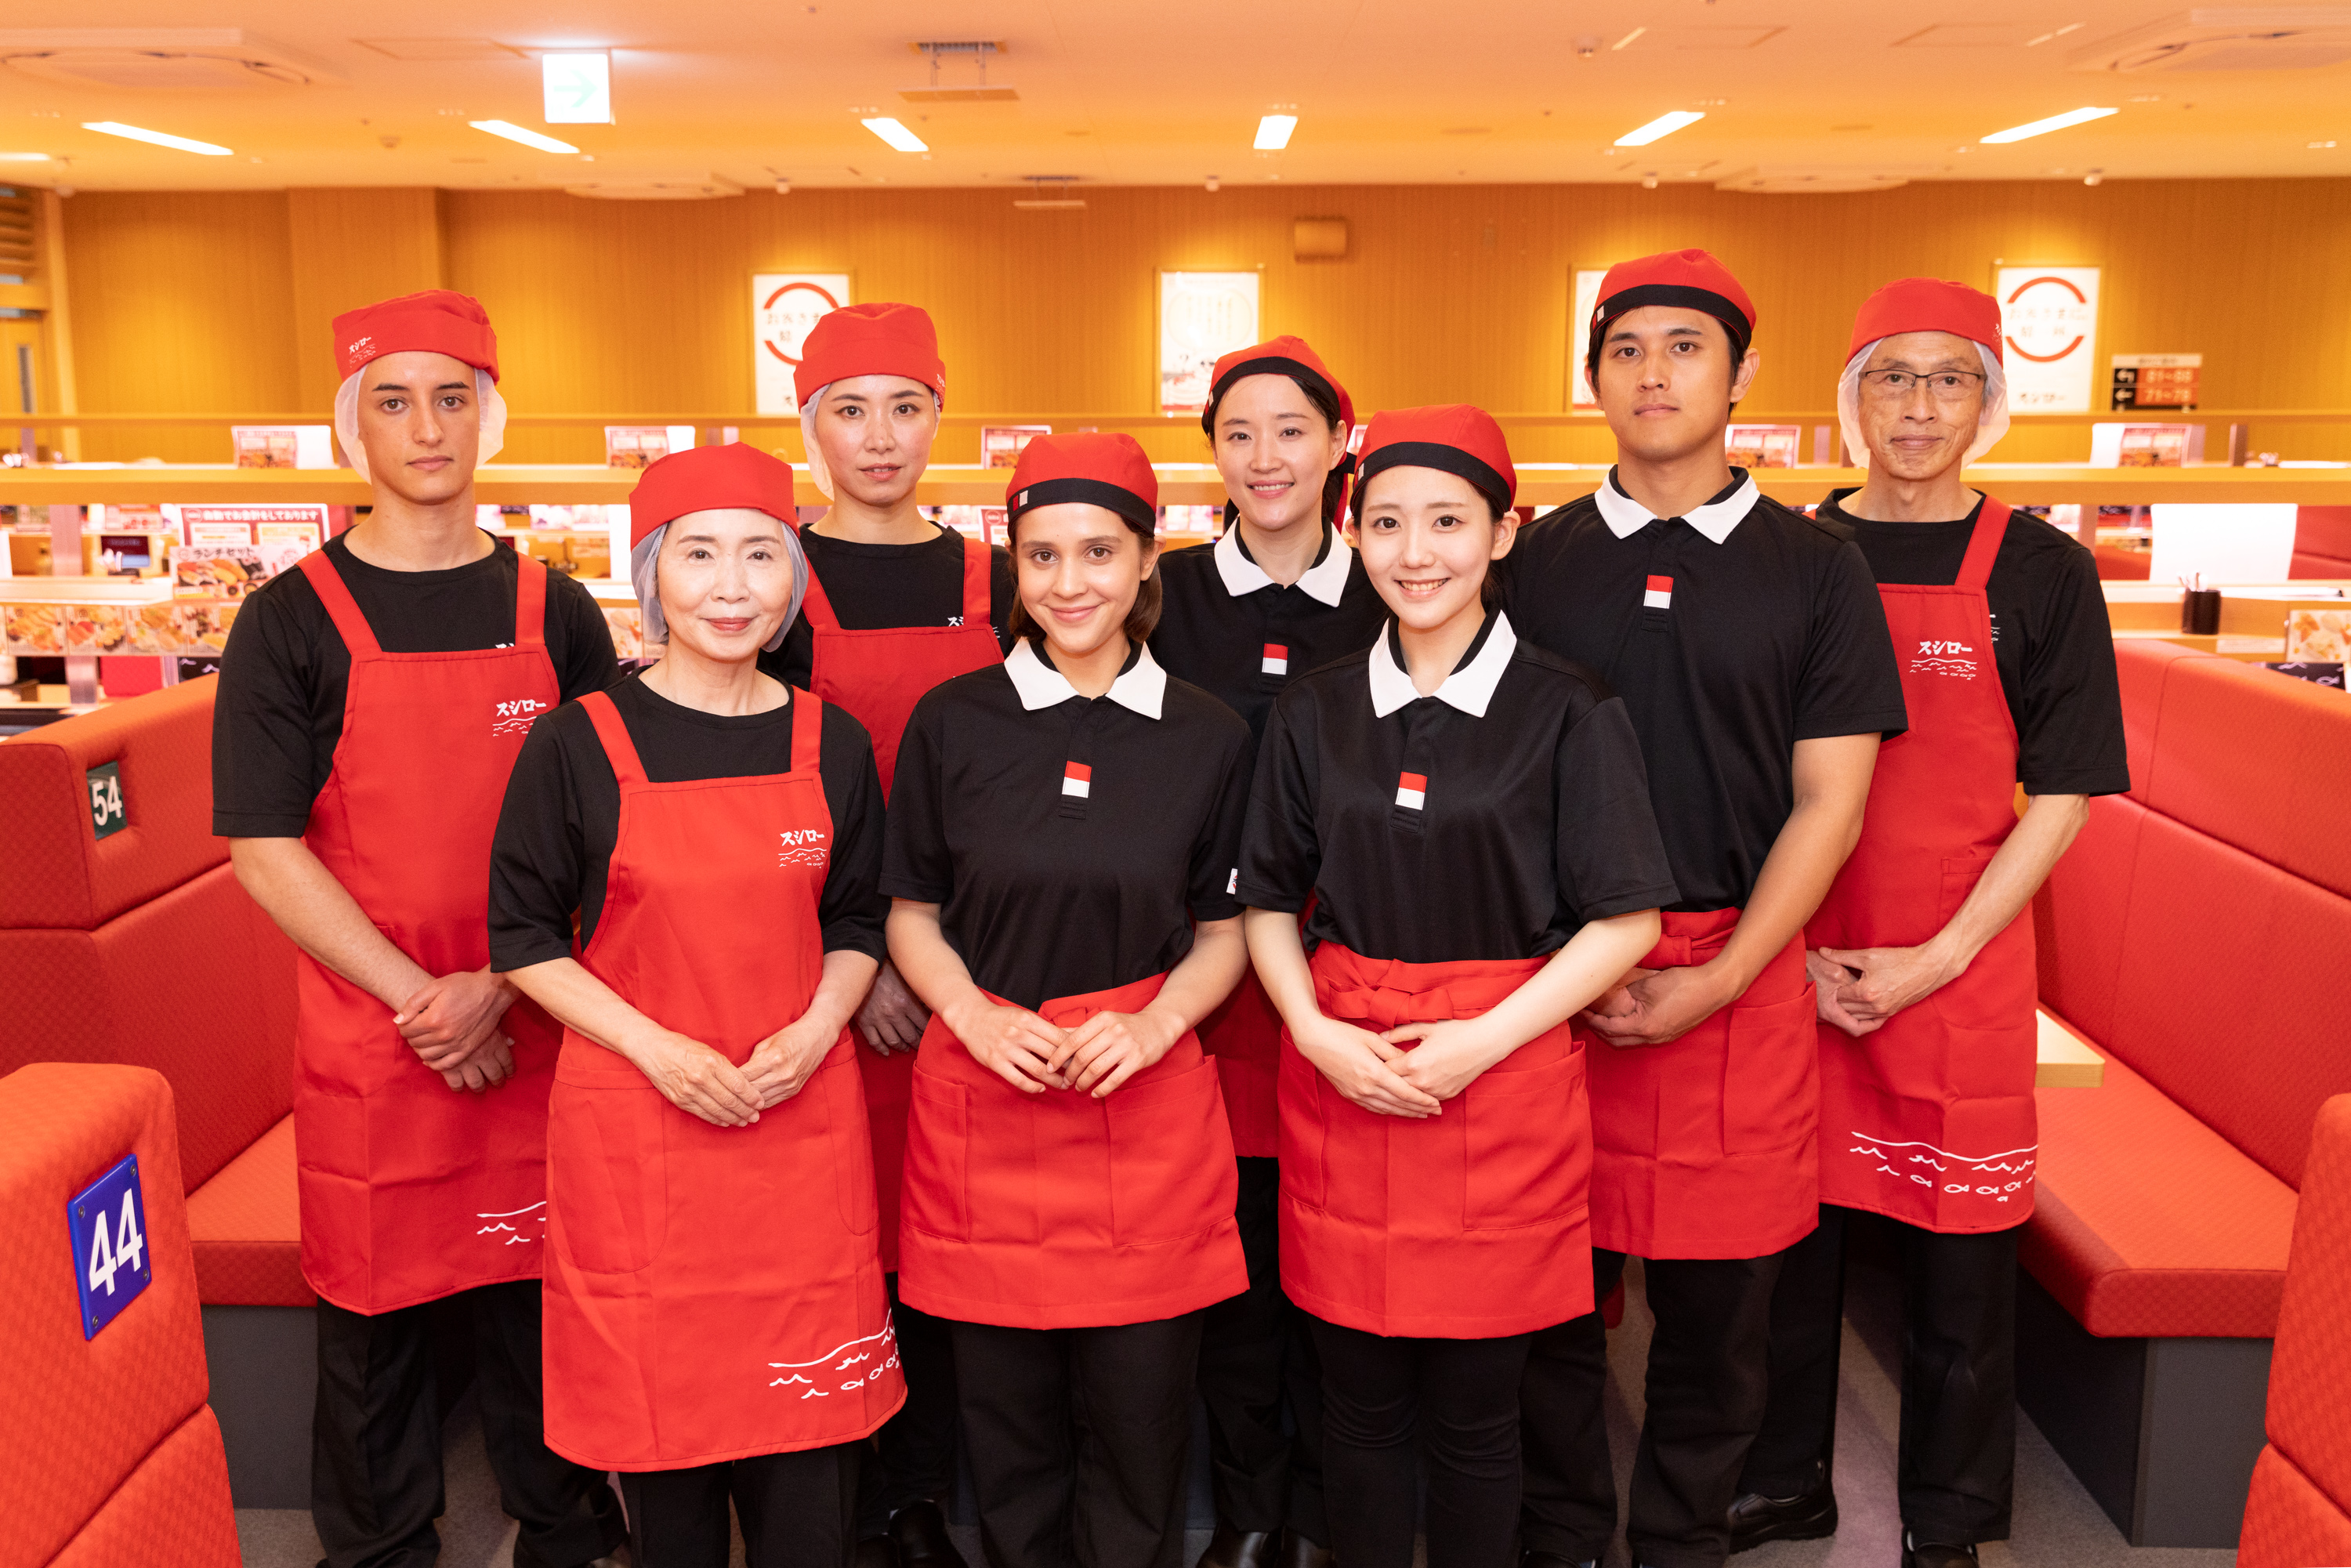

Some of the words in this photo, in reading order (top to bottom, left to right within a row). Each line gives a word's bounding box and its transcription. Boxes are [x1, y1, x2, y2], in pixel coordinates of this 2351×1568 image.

[349, 336, 371, 355] スシロー
[1917, 640, 1973, 655] スシロー
[496, 699, 547, 717] スシロー
[92, 775, 123, 826] 54
[780, 829, 825, 846] スシロー
[89, 1187, 143, 1297] 44
